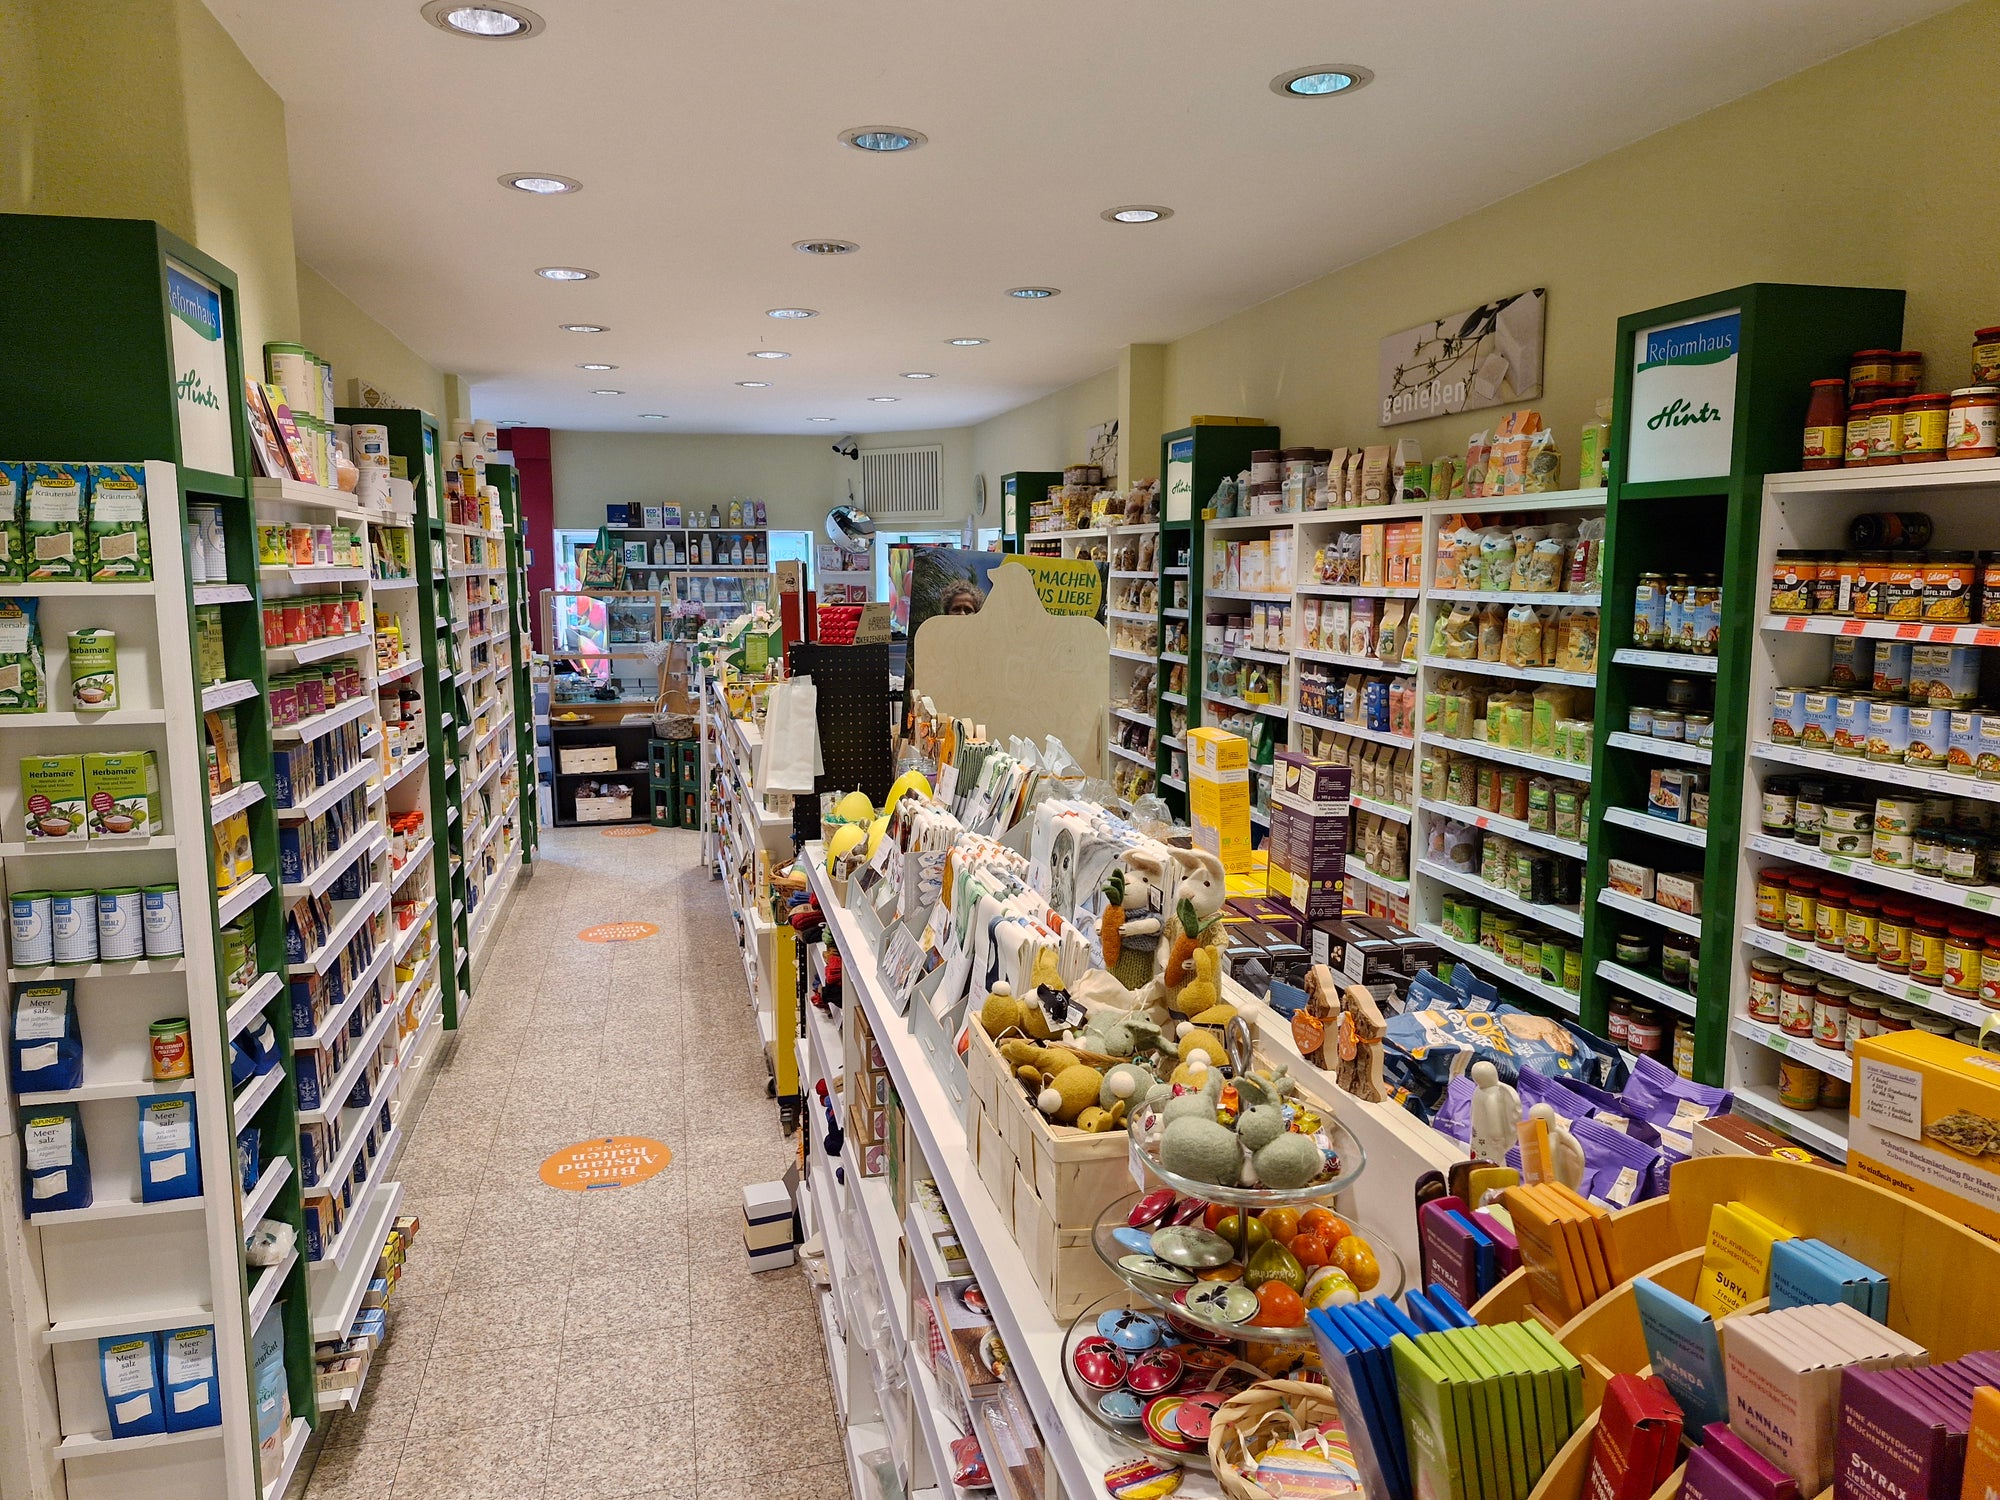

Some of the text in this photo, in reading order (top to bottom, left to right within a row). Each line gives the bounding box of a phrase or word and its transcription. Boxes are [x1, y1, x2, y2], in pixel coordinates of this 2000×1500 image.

[1649, 333, 1732, 366] Reformhaus
[176, 369, 220, 411] Hintz
[1383, 380, 1466, 423] genießen
[1647, 398, 1721, 430] Hintz
[41, 479, 75, 487] RAPUNZEL
[103, 482, 138, 490] RAPUNZEL
[35, 489, 77, 499] Kräutersalz
[100, 493, 143, 501] Kräutersalz
[1039, 569, 1097, 589] MACHEN
[1890, 572, 1912, 581] Eden
[1926, 572, 1950, 581] Eden
[1037, 587, 1094, 606] US LIEBE
[0, 610, 21, 618] UNZEL
[1045, 607, 1067, 616] SSERE
[29, 770, 74, 779] Herbamare
[92, 768, 137, 776] Herbamare
[1832, 860, 1848, 869] vegan
[1969, 898, 1987, 906] vegan
[1909, 991, 1927, 999] vegan
[33, 1006, 49, 1015] salz
[1770, 1038, 1786, 1046] vegan
[31, 1117, 64, 1125] RAPUNZEL
[154, 1112, 179, 1121] Meer-
[159, 1118, 175, 1127] salz
[33, 1128, 60, 1138] Meer-
[38, 1135, 55, 1144] salz
[571, 1146, 648, 1162] halten
[1880, 1138, 1908, 1156] Schnelle
[1908, 1149, 1961, 1178] Backmischung
[1962, 1171, 1976, 1183] für
[557, 1153, 660, 1175] Abstand
[577, 1165, 637, 1179] Bitte
[1857, 1161, 1916, 1193] So einfach geht's:
[1886, 1149, 1994, 1200] Zubereitung 5 Minuten, Backzeit
[1712, 1230, 1764, 1267] REINE AYURVEDISCHE
[1712, 1238, 1760, 1275] RÄUCHERSTÄBCHEN
[1431, 1258, 1459, 1288] STYRAX
[1773, 1272, 1790, 1284] REINE
[1715, 1271, 1748, 1302] SURYA
[1717, 1288, 1741, 1309] Freude
[179, 1341, 202, 1350] Meer-
[183, 1347, 199, 1356] salz
[115, 1353, 140, 1363] Meer-
[254, 1340, 279, 1368] aturGut
[121, 1361, 136, 1369] salz
[1656, 1350, 1705, 1390] ANANDA
[1748, 1366, 1797, 1406] AYURVEDISCHE
[1737, 1395, 1794, 1446] NANNARI
[1411, 1418, 1434, 1449] TULSI
[1745, 1417, 1789, 1457] Reinigung
[1845, 1404, 1924, 1464] REINE AYURVEDISCHE
[1846, 1414, 1921, 1475] RÄUCHERSTÄBCHEN
[1851, 1452, 1907, 1500] STYRAX
